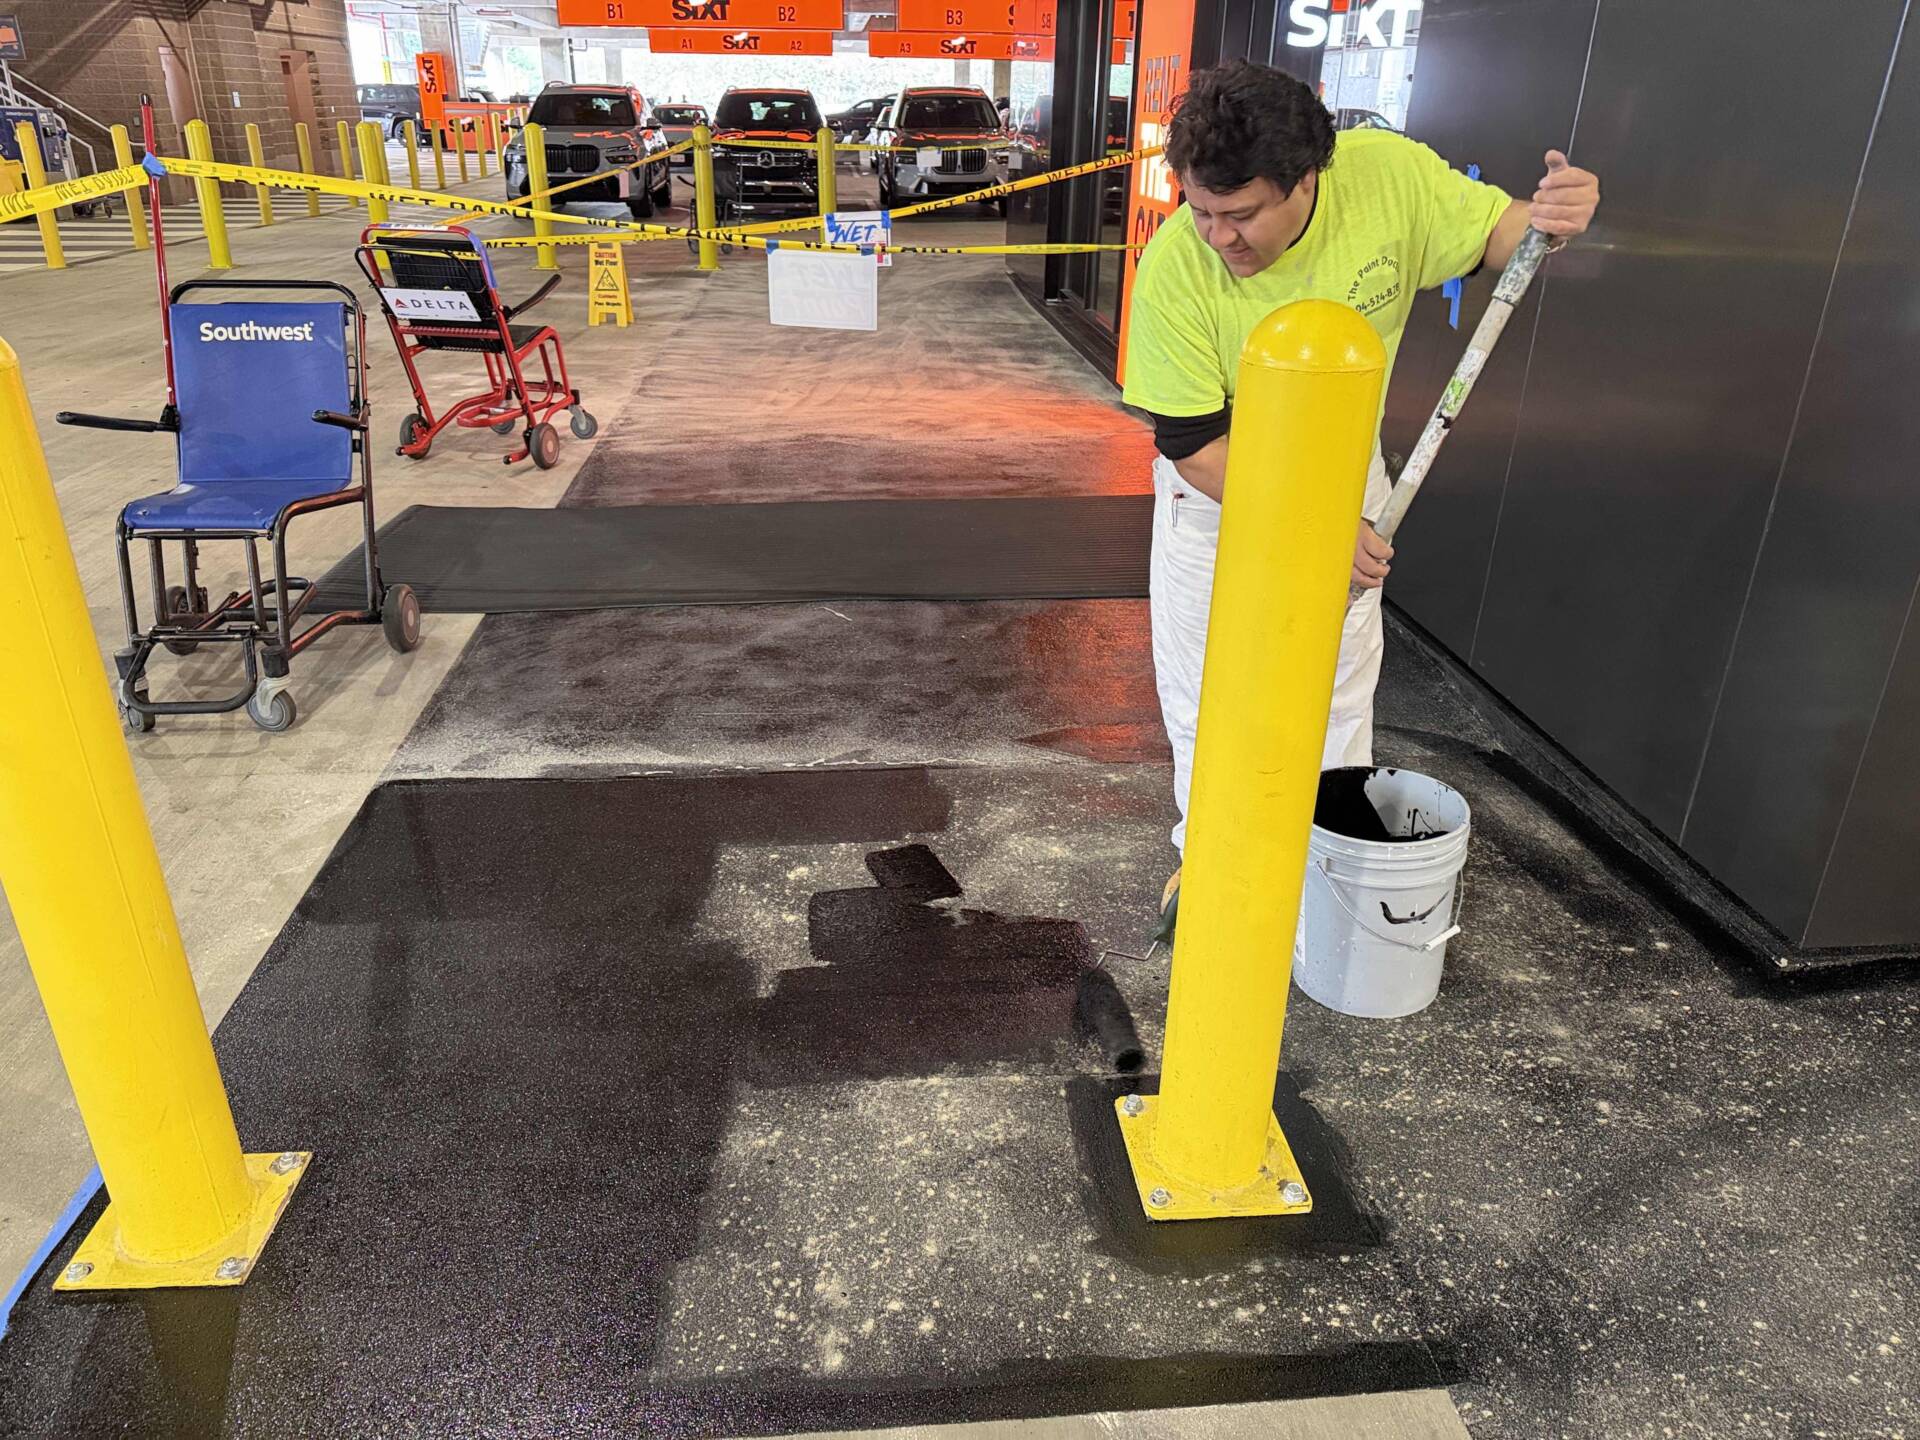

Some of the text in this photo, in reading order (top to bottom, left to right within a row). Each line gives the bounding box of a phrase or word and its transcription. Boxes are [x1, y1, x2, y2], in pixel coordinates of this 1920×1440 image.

[607, 3, 624, 19] B1
[778, 6, 796, 22] B2
[946, 9, 964, 25] B3
[681, 39, 693, 49] A1
[790, 40, 802, 51] A2
[899, 43, 911, 53] A3
[1143, 54, 1182, 113] RENT
[830, 220, 877, 243] WET
[1347, 280, 1360, 302] The
[1357, 258, 1380, 279] Paint
[410, 299, 470, 311] DELTA
[200, 320, 313, 341] Southwest
